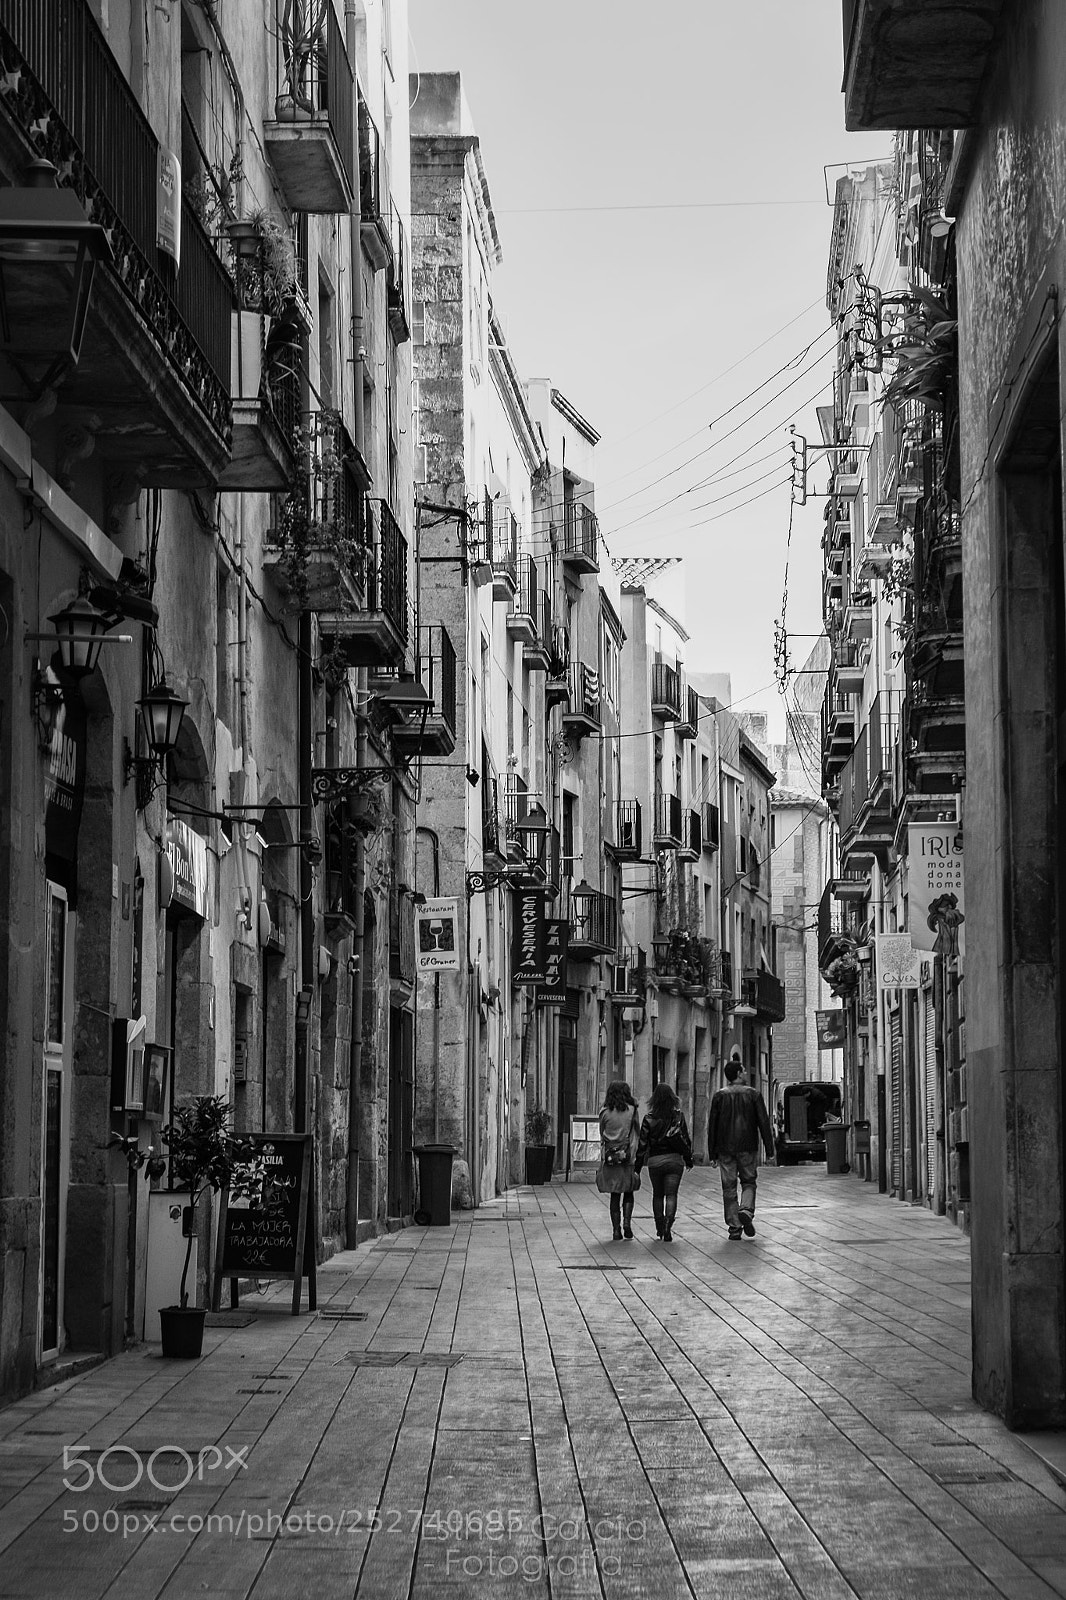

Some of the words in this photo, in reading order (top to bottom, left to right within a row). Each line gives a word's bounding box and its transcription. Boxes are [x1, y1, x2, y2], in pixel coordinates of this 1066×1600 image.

[176, 847, 189, 882] Bon
[927, 860, 961, 869] moda
[927, 870, 961, 879] dona
[928, 880, 962, 889] home
[416, 904, 455, 914] Restaurant
[520, 896, 539, 967] CERVESERIA
[547, 925, 560, 946] LA
[231, 1221, 246, 1232] LA
[252, 1219, 292, 1234] MUJER
[229, 1235, 294, 1249] TRABAJADORA
